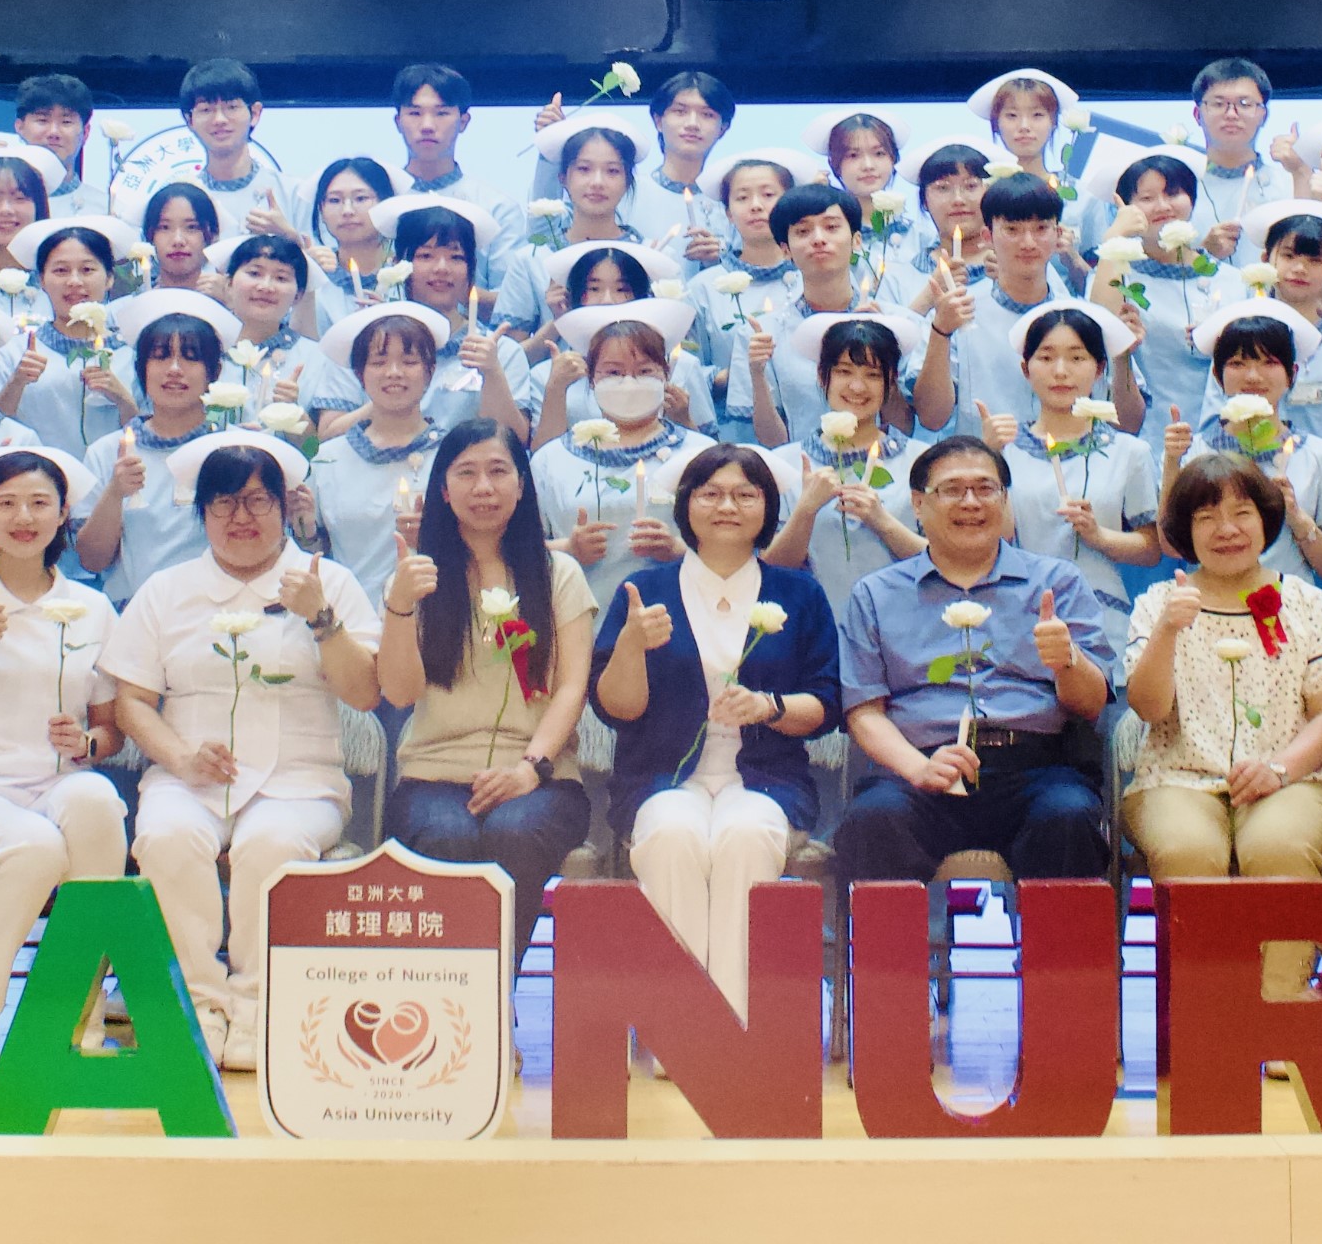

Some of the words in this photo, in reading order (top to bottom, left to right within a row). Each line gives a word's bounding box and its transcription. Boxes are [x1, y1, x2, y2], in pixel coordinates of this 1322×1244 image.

[347, 885, 424, 902] 亞洲大學
[325, 910, 444, 938] 護理學院
[305, 967, 368, 985] College
[376, 968, 395, 982] of
[402, 968, 469, 986] Nursing
[369, 1077, 406, 1086] SINCE
[323, 1107, 358, 1121] Asia
[365, 1108, 453, 1125] University
